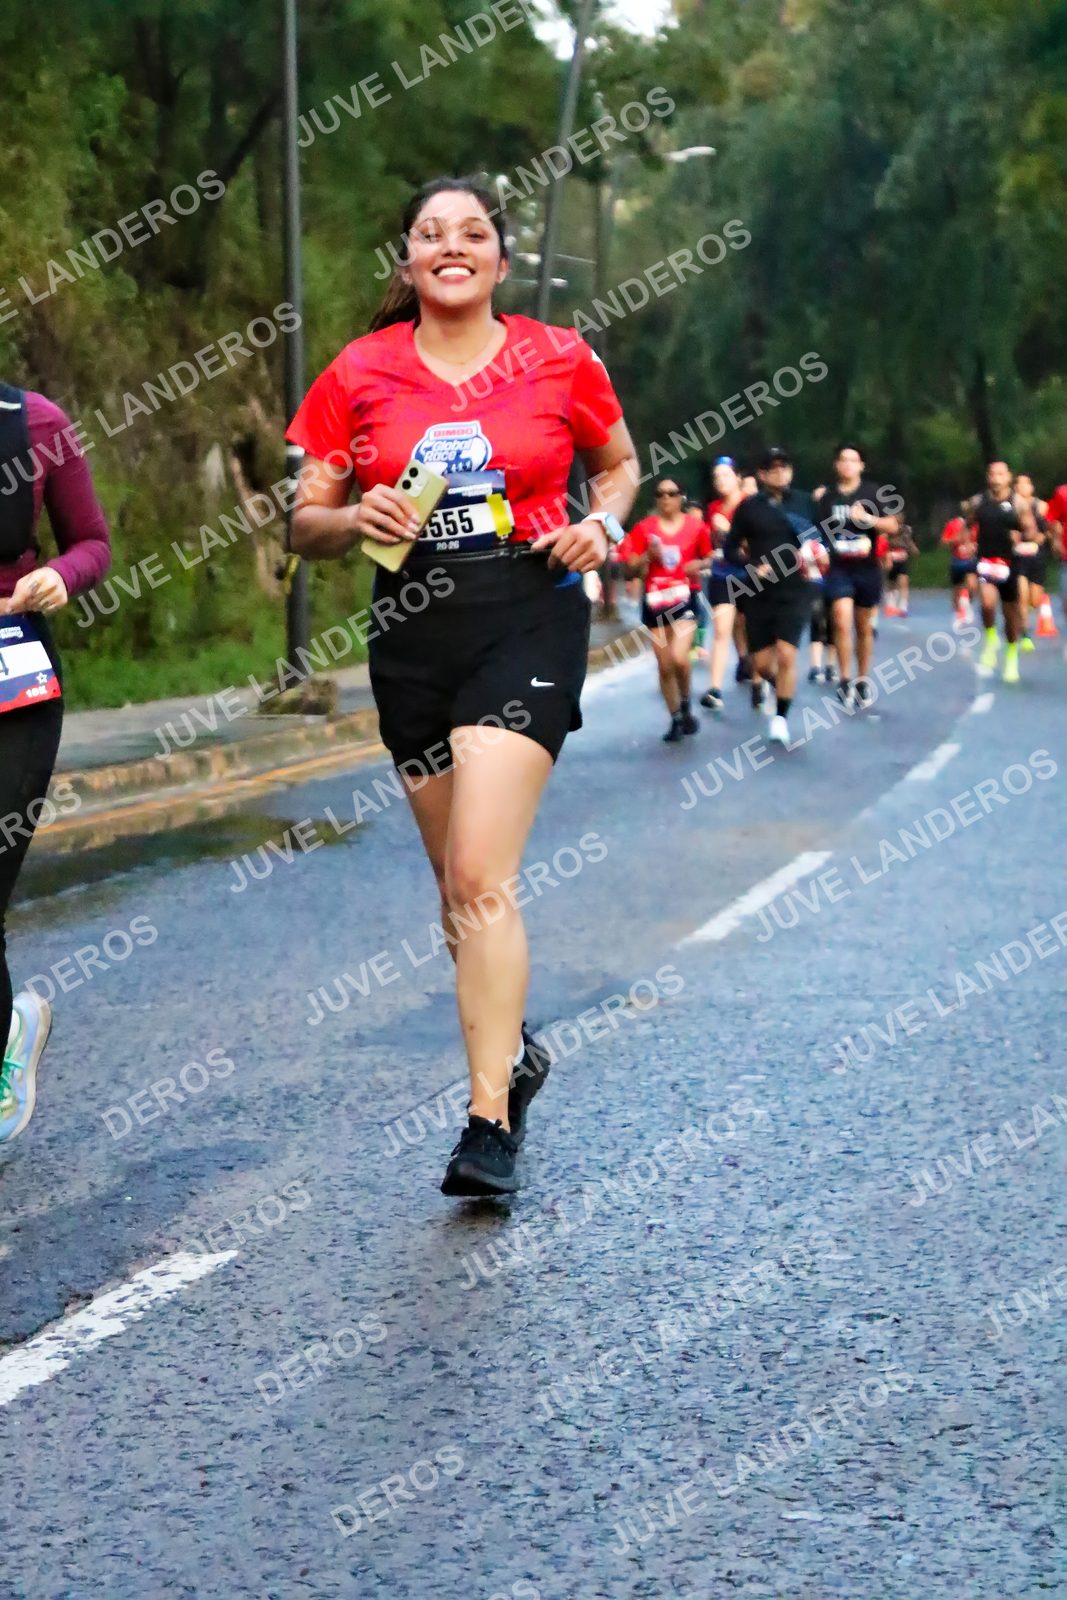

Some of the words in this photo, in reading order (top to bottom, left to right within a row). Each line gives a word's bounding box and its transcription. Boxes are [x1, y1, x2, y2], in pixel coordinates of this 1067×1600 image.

[434, 428, 473, 437] BIMBO
[433, 440, 472, 450] Global
[424, 450, 457, 462] Race
[419, 508, 474, 539] 555
